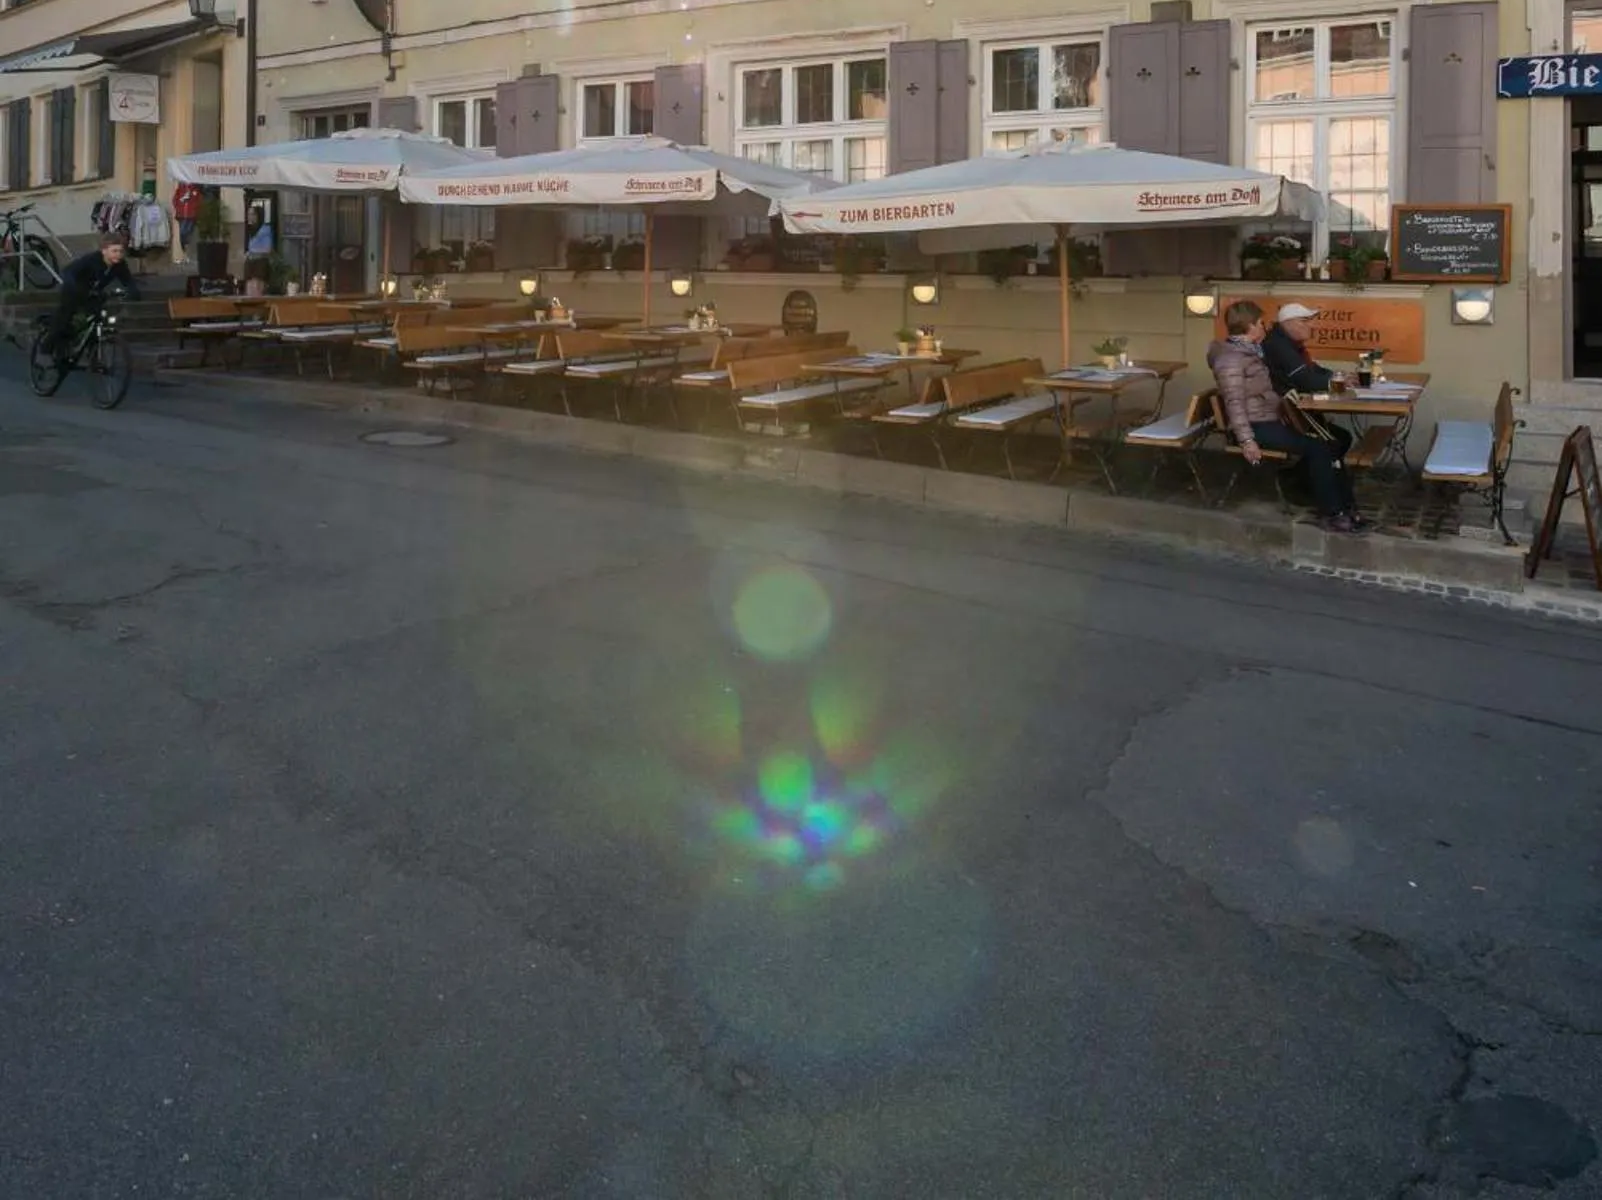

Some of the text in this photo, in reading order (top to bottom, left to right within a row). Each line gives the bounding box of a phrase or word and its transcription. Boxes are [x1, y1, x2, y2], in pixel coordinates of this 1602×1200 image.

[1206, 192, 1227, 204] am
[840, 202, 955, 223] ZUM BIERGARTEN
[1310, 327, 1380, 344] rgarten
